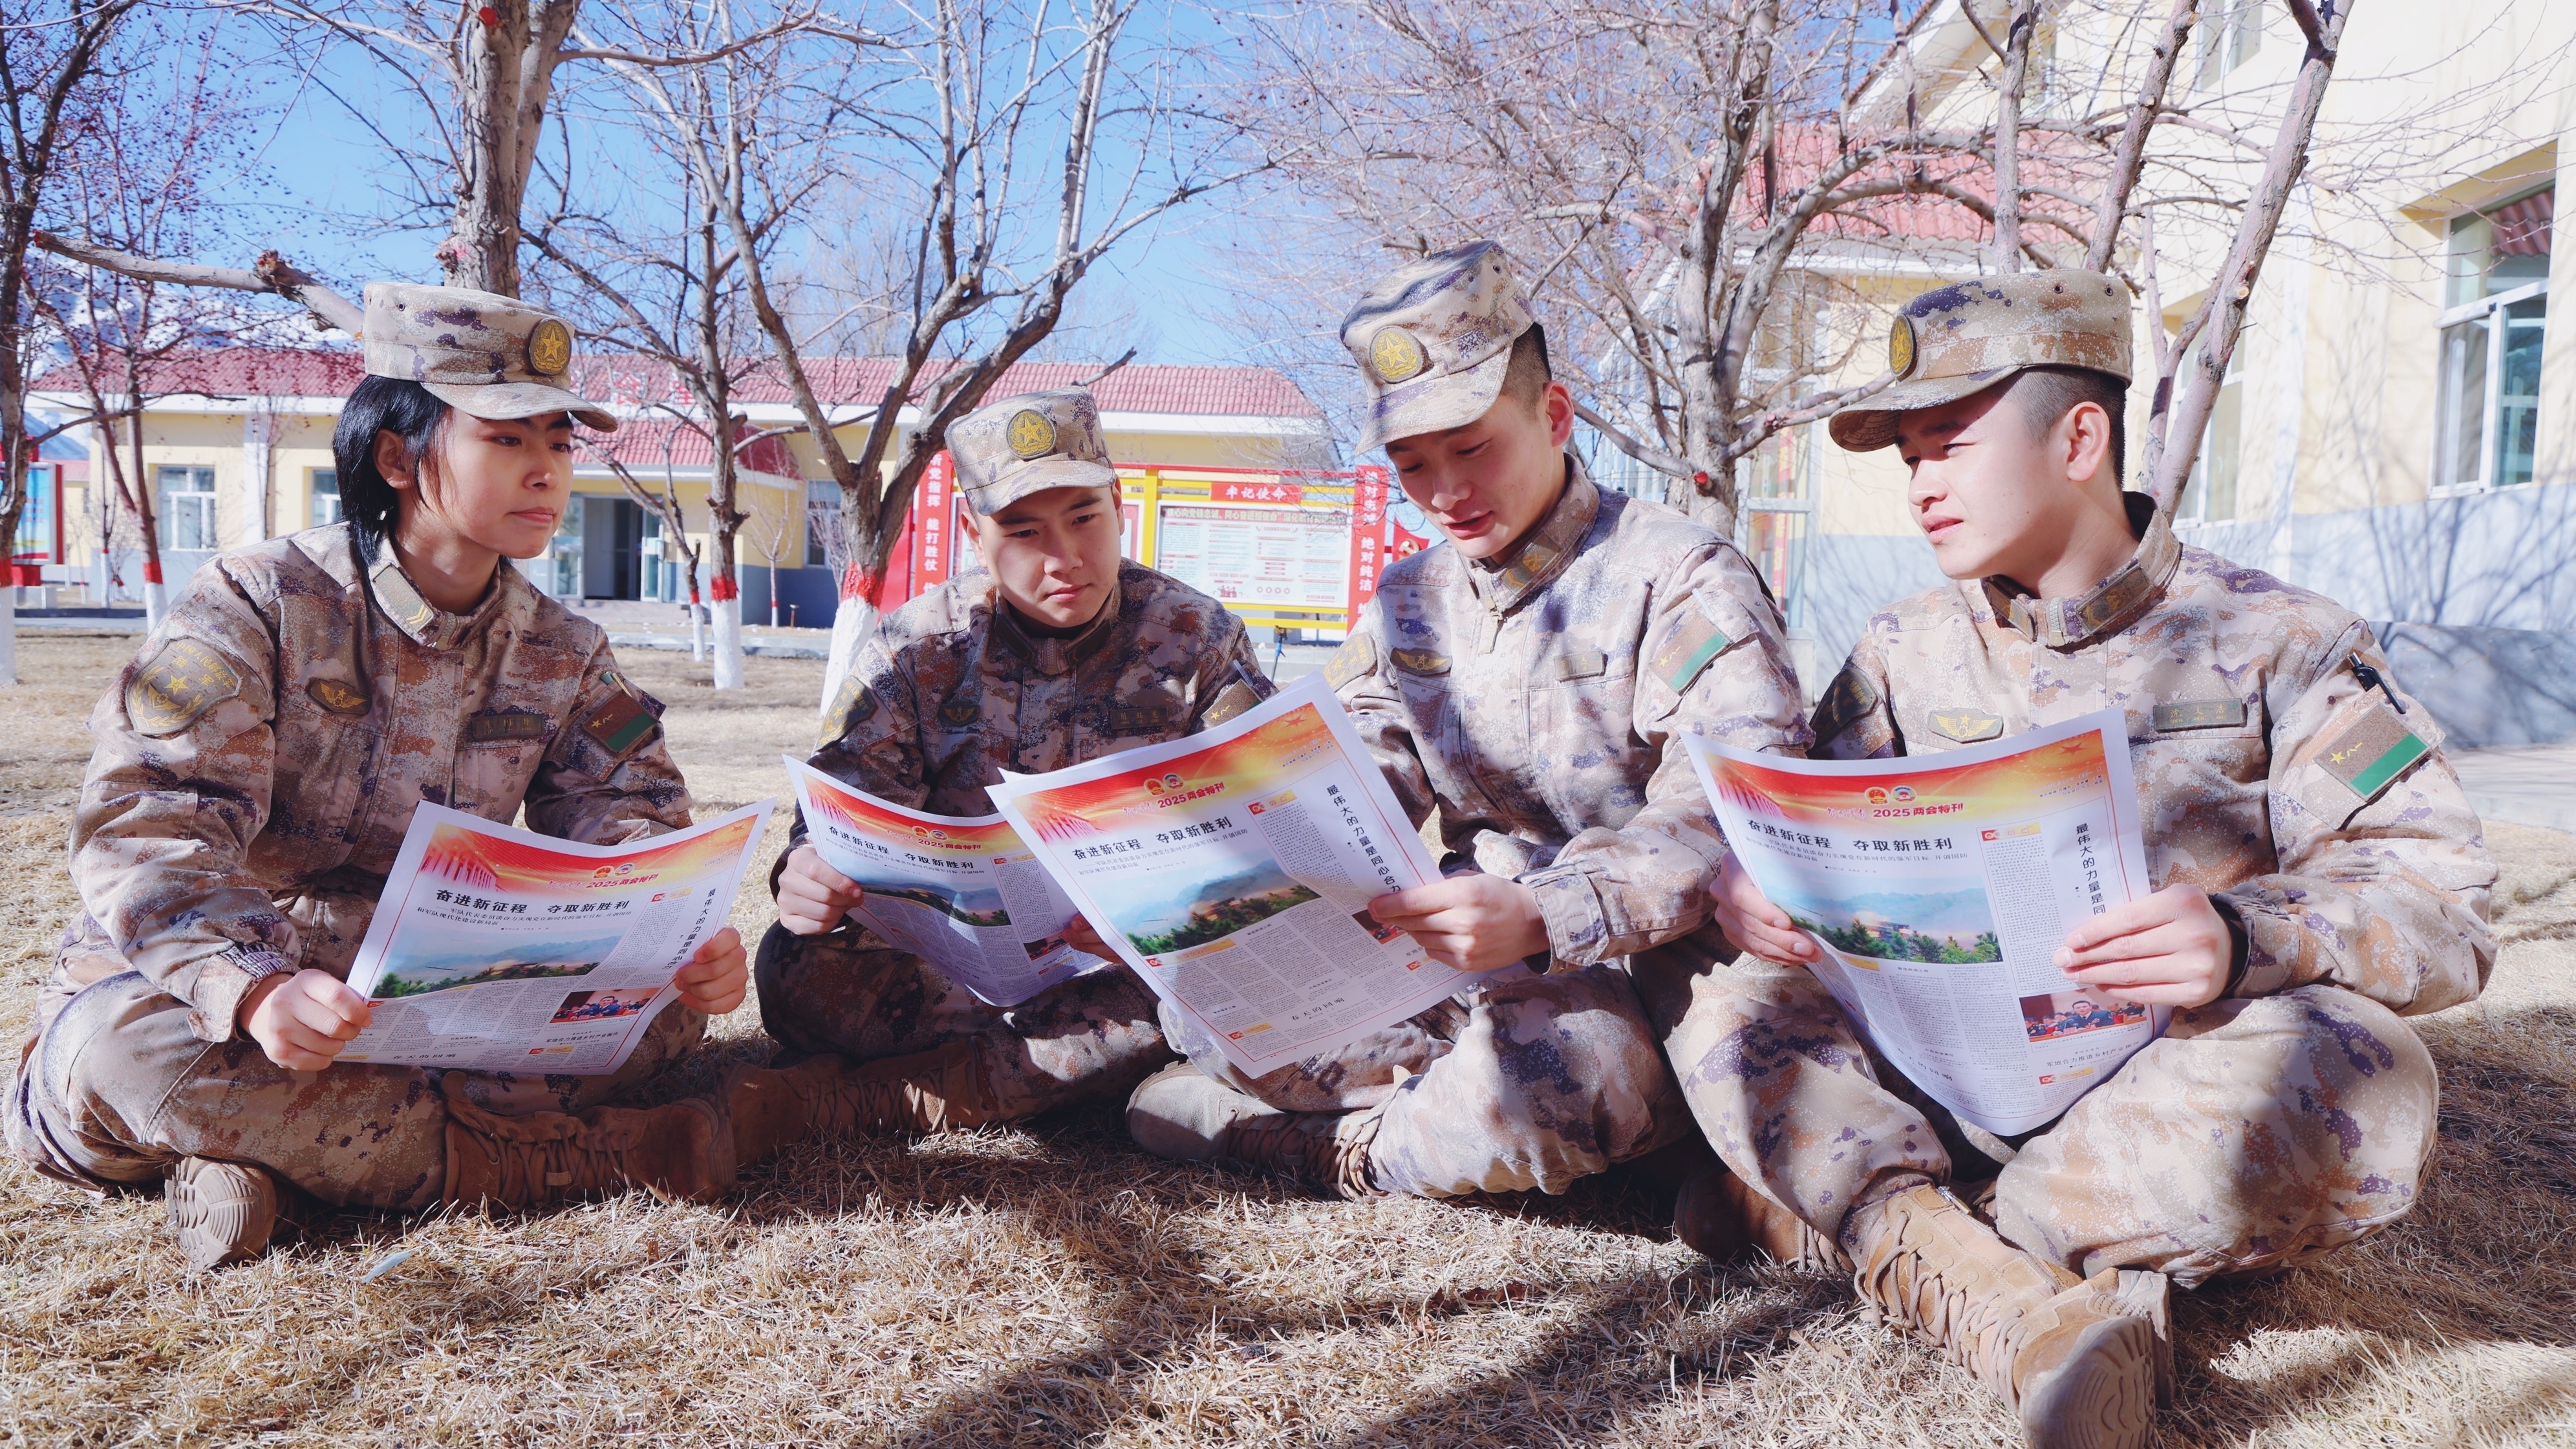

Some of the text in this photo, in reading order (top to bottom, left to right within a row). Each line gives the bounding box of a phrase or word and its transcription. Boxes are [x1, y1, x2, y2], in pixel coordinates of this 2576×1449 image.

[1225, 484, 1287, 501] 牢记使命
[924, 517, 939, 572] 能打胜仗
[1359, 537, 1375, 592] 绝对纯洁
[176, 642, 235, 688] 中国人民解放军
[828, 824, 974, 869] 奋进新征程 夺取新胜利
[1072, 816, 1232, 860] 奋进新征程 夺取新胜利
[1327, 784, 1402, 893] 最伟大的力量是同心合力
[1746, 819, 1953, 852] 奋进新征程 夺取新胜利
[2076, 823, 2106, 916] 最伟大的力量是同
[436, 890, 630, 914] 奋进新征程 夺取新胜利
